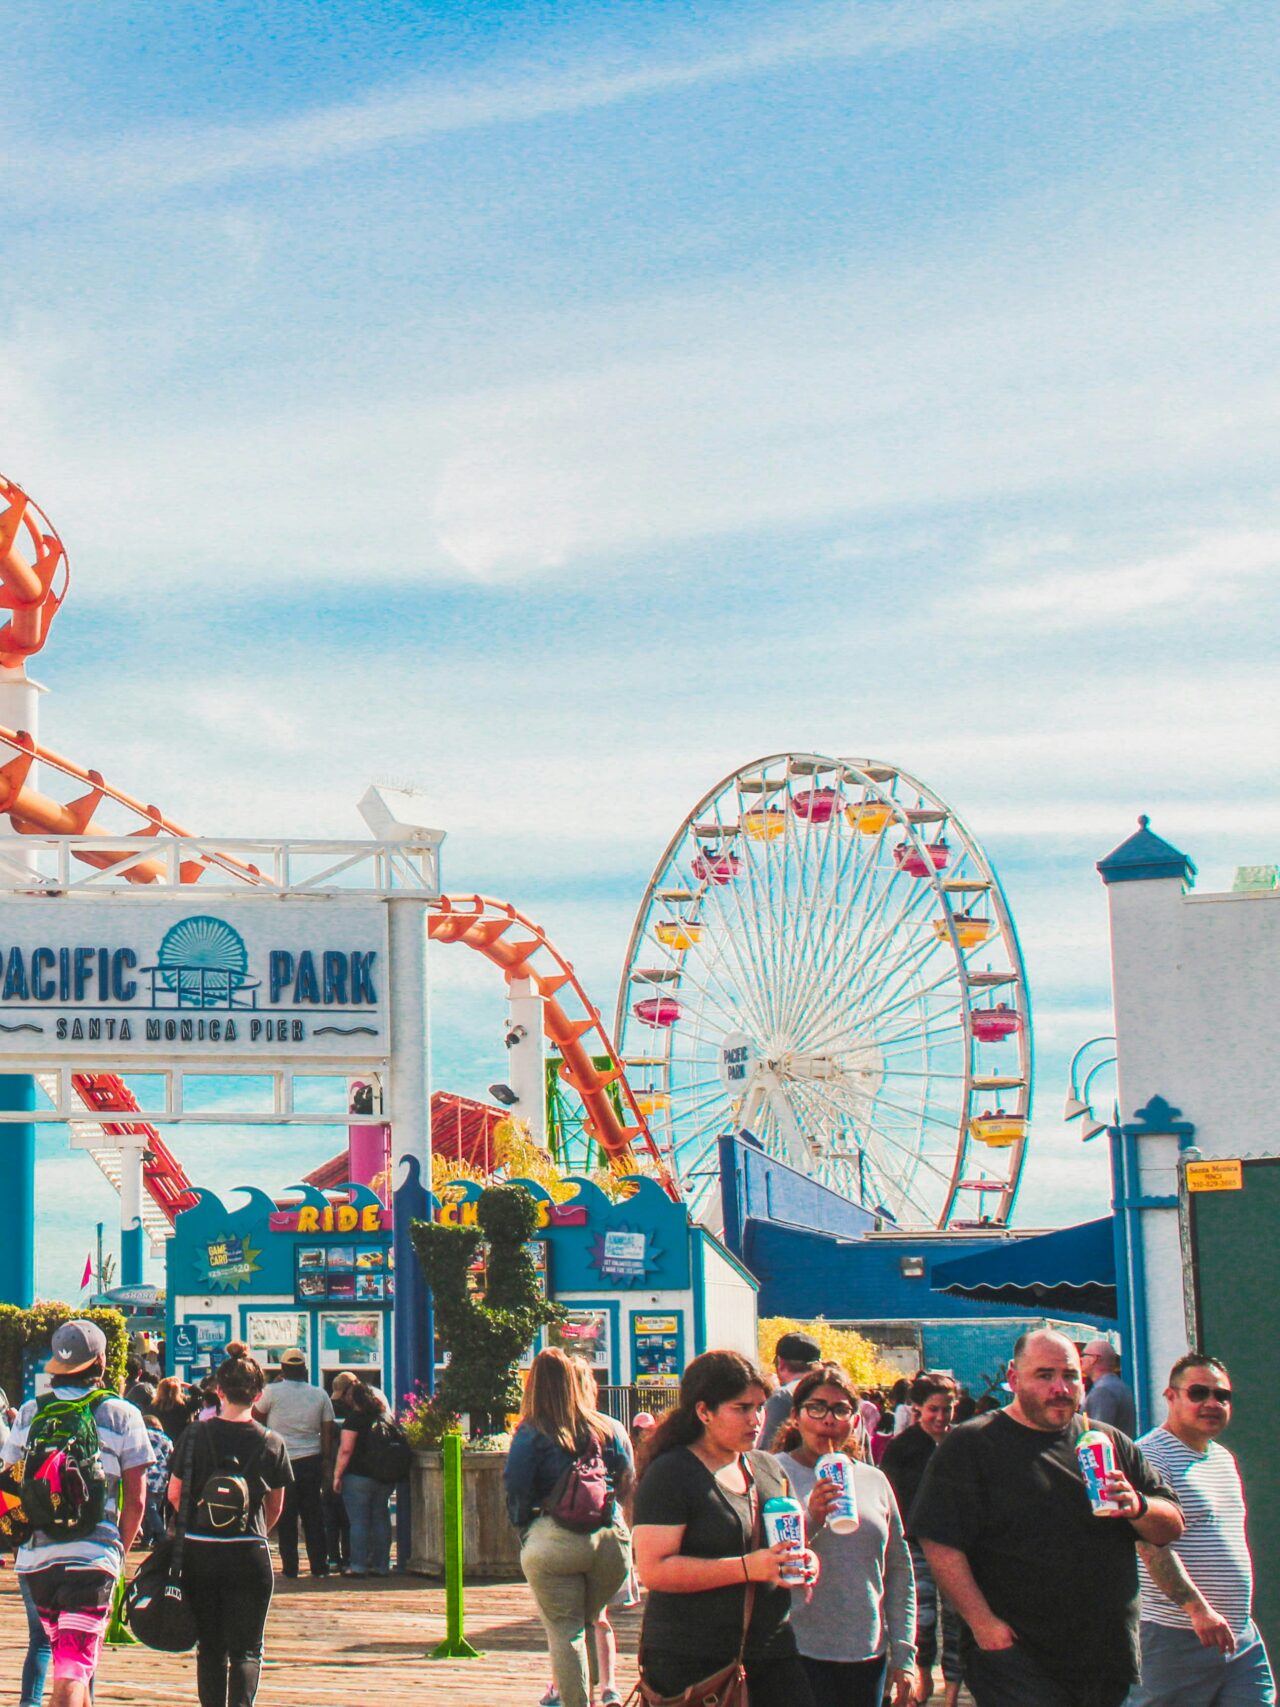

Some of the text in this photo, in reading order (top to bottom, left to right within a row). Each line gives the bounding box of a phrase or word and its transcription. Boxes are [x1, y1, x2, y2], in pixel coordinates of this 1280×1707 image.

[269, 950, 377, 1004] PARK
[56, 1017, 304, 1042] SANTA MONICA PIER
[723, 1046, 748, 1064] PACIFIC
[727, 1064, 746, 1080] PARK
[297, 1204, 381, 1232] RIDE
[208, 1244, 227, 1256] GAME
[209, 1254, 228, 1266] CARD
[337, 1323, 373, 1337] OPEN
[372, 1352, 377, 1361] 8
